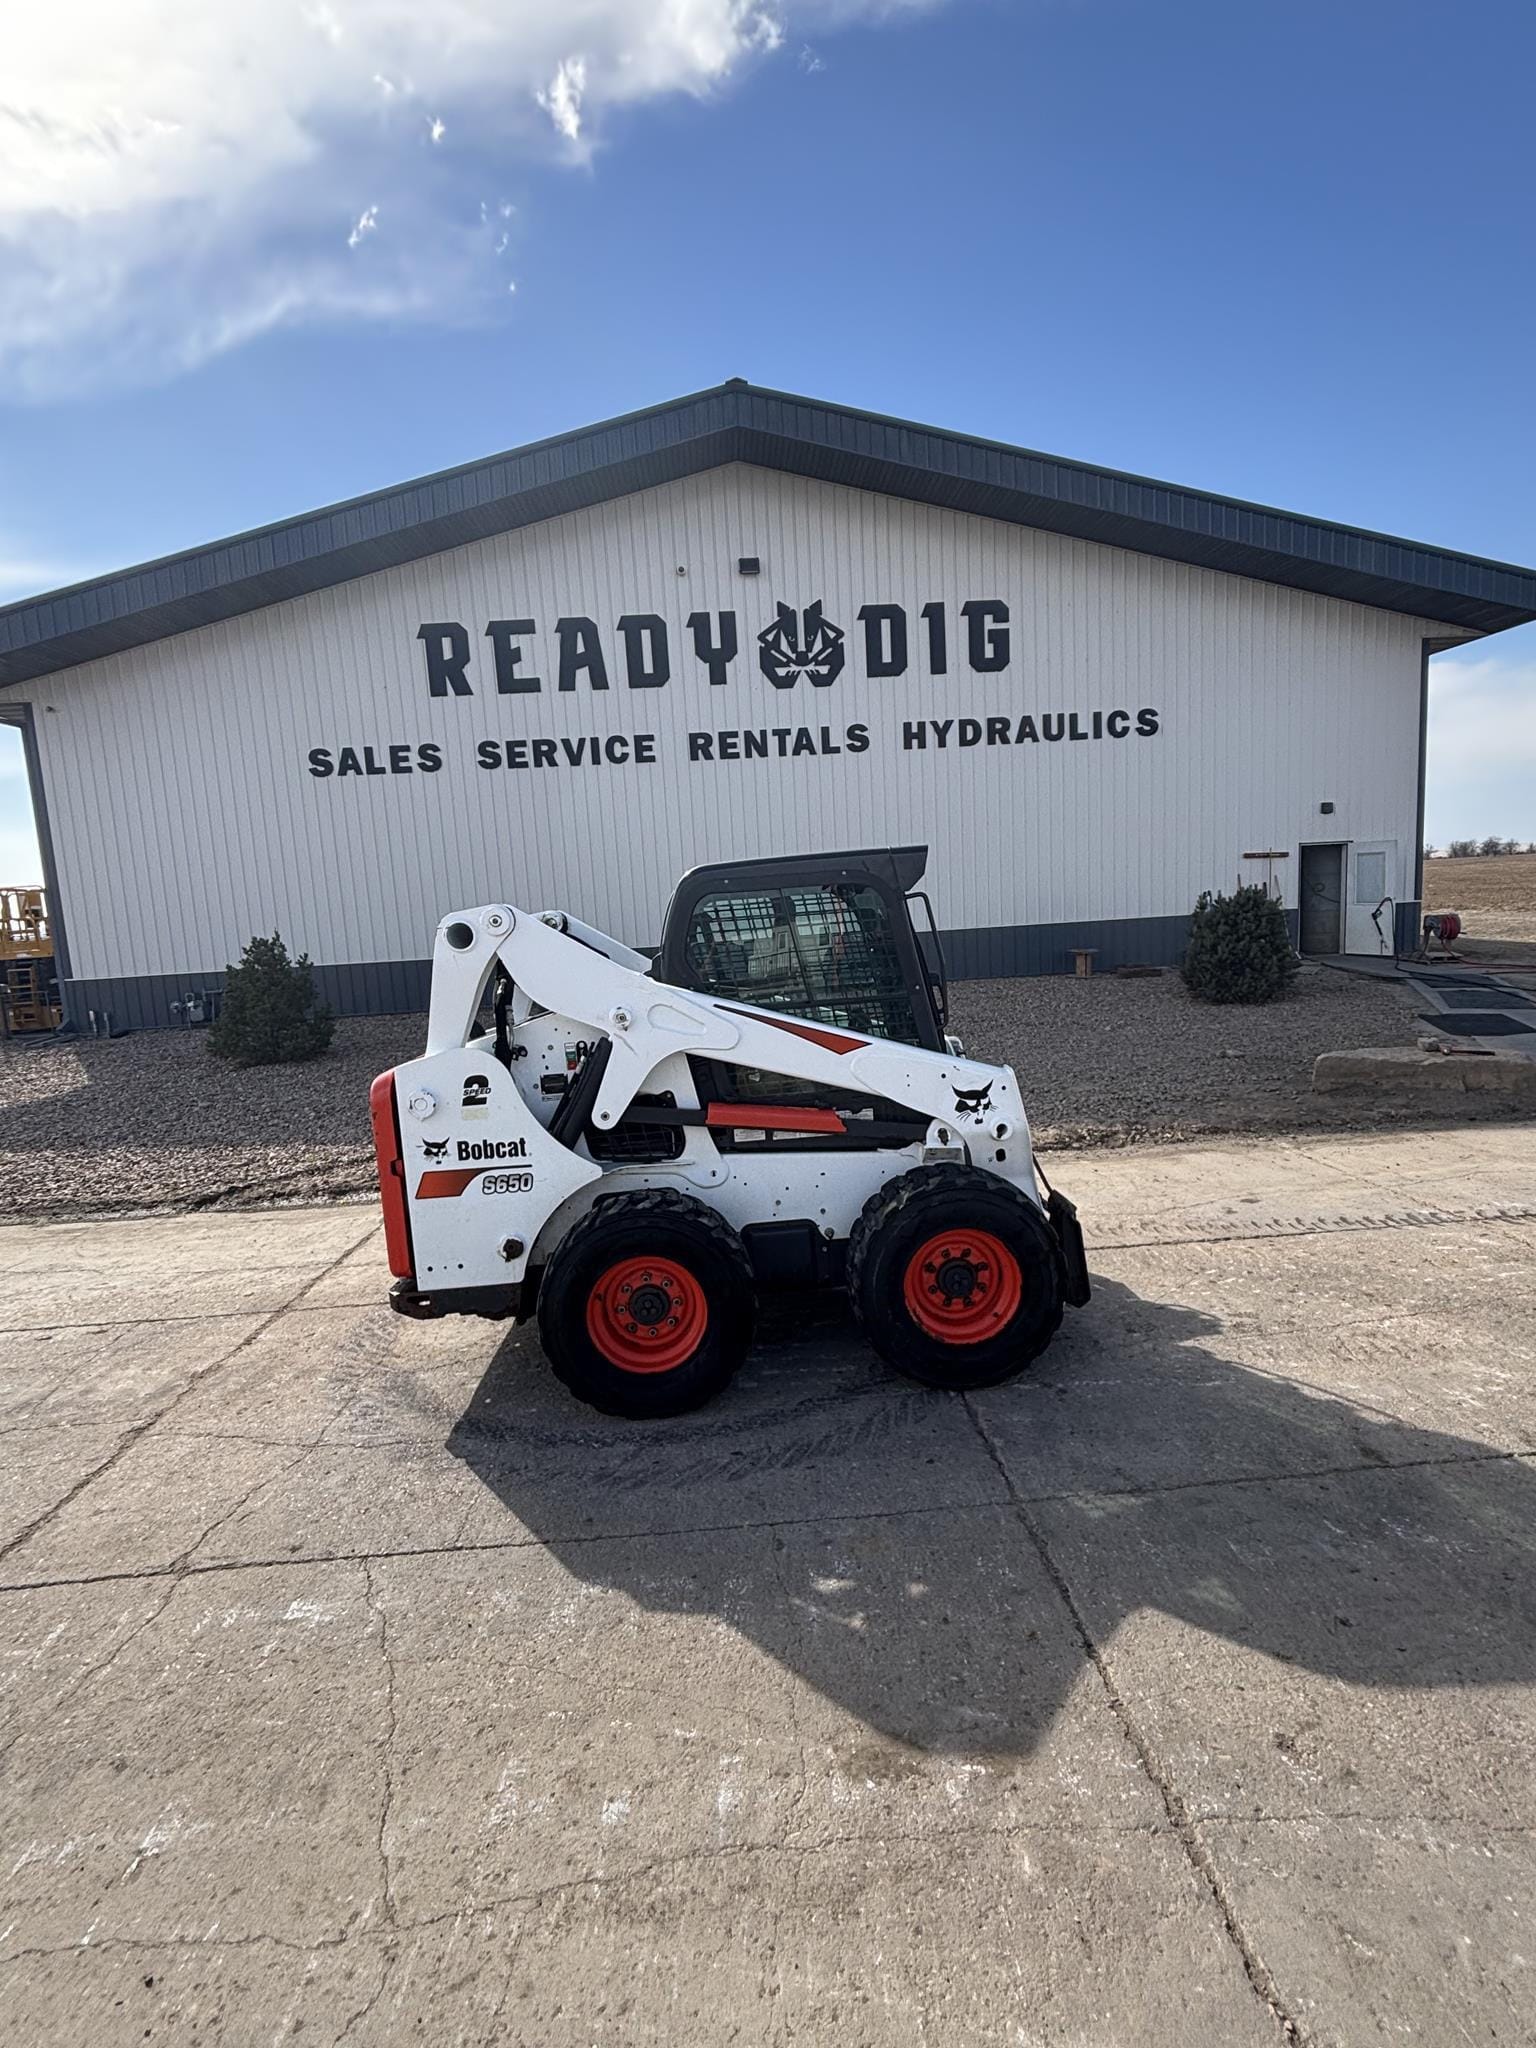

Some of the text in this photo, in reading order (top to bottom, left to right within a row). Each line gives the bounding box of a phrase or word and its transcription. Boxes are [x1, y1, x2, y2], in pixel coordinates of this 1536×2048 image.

[417, 599, 1011, 698] READY DIG
[308, 708, 1160, 778] SALES SERVICE RENTALS HYDRAULICS
[461, 1074, 489, 1107] 2
[463, 1086, 492, 1097] SPEED
[456, 1137, 527, 1161] Bobcat
[482, 1172, 534, 1196] S650
